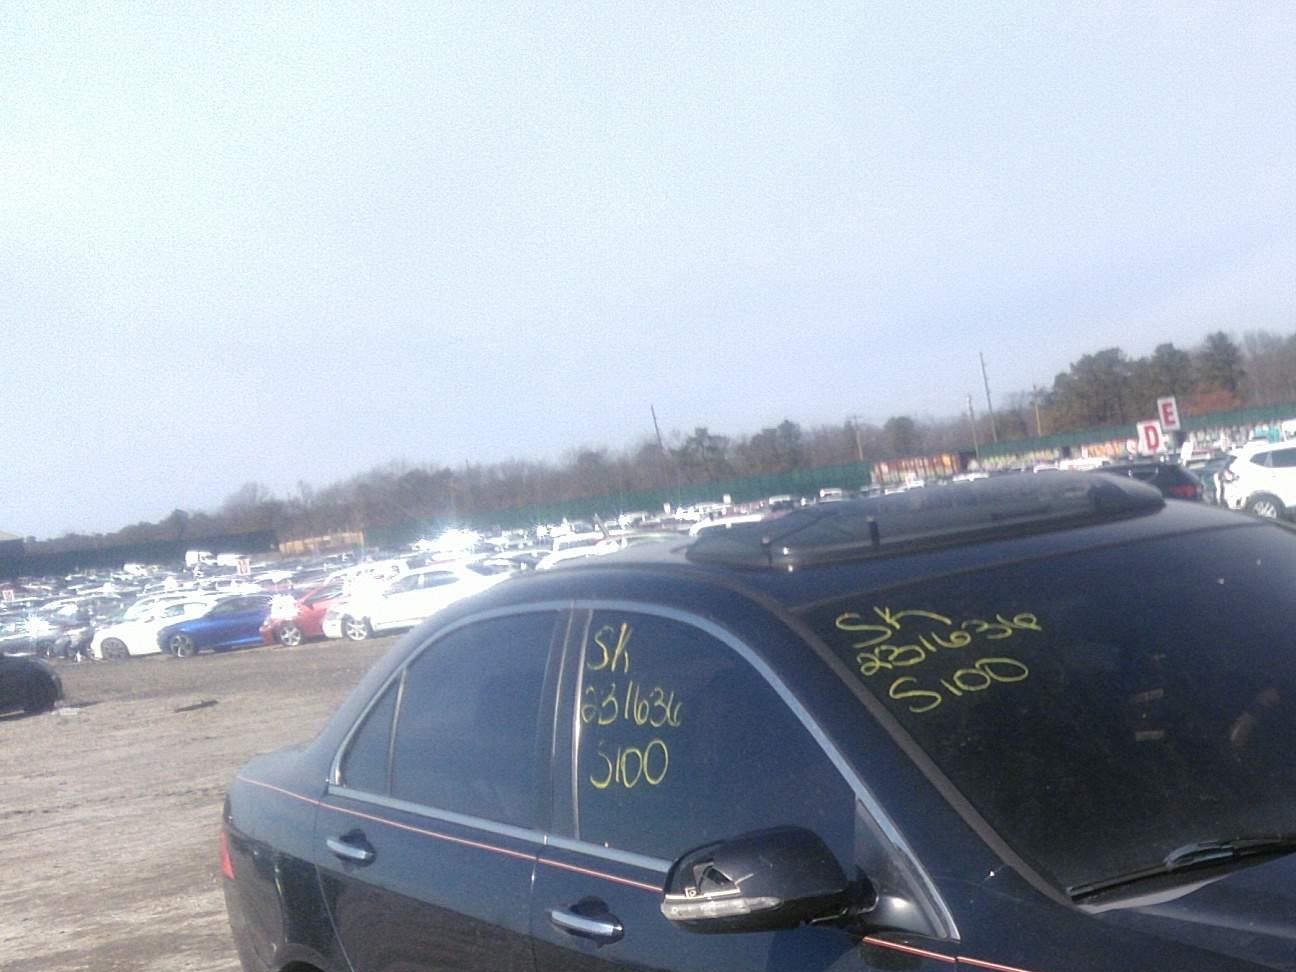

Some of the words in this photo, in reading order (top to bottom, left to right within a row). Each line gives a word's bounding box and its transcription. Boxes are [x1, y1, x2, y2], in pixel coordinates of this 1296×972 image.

[1162, 402, 1176, 427] E
[1144, 425, 1160, 451] D
[889, 657, 1029, 713] S100
